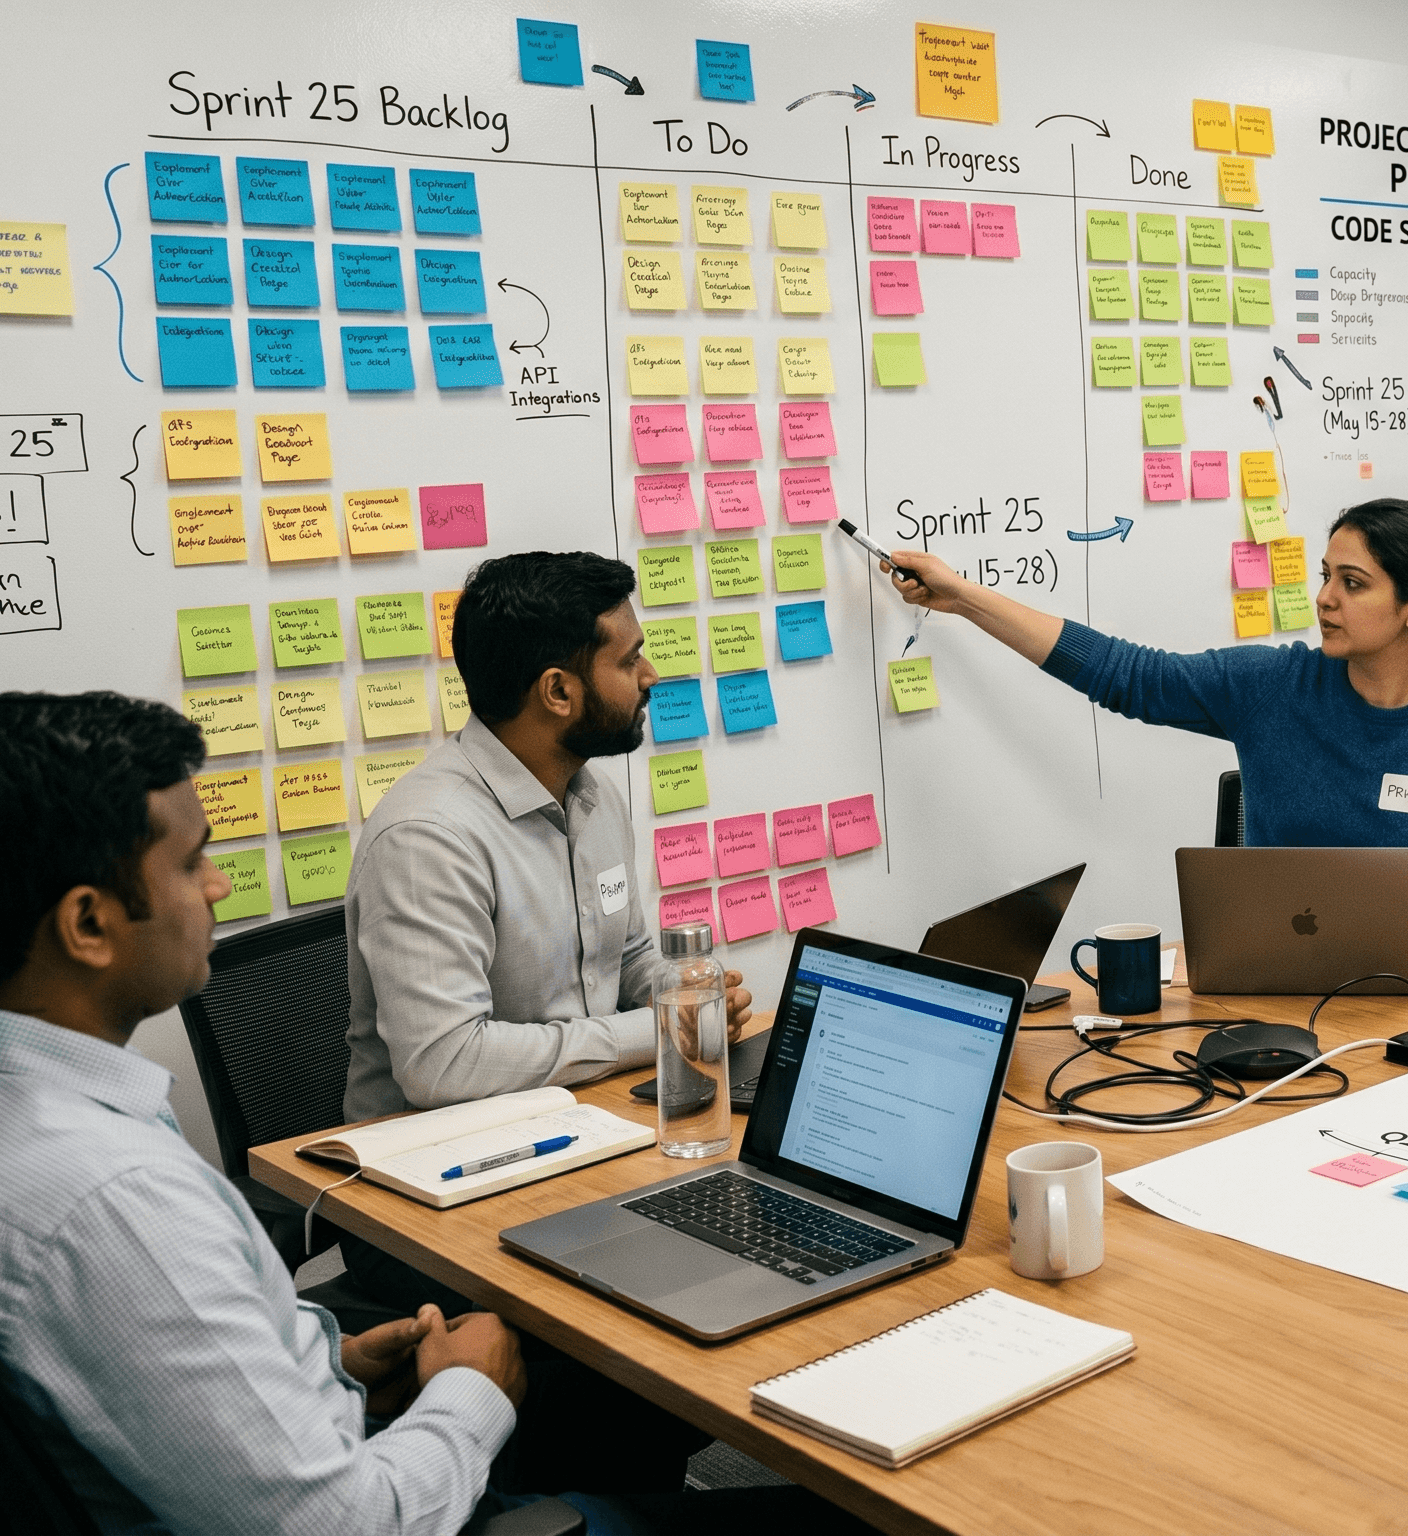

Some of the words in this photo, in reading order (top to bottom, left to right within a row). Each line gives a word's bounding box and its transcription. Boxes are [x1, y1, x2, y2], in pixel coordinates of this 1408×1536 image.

[168, 71, 292, 131] Sprint
[308, 82, 359, 122] 25
[380, 86, 510, 153] Backlog
[653, 120, 693, 153] To
[707, 122, 748, 155] Do
[881, 135, 914, 165] In
[925, 135, 1020, 182] Progress
[1130, 154, 1191, 189] Done
[1331, 215, 1392, 244] CODE
[1330, 266, 1376, 285] Capacity
[521, 366, 559, 385] API
[509, 390, 600, 414] Integrations
[1322, 376, 1374, 407] Sprint
[1380, 376, 1405, 401] 25
[1323, 411, 1360, 440] (May
[10, 429, 54, 457] 25
[896, 497, 992, 553] Sprint
[1004, 497, 1044, 533] 25
